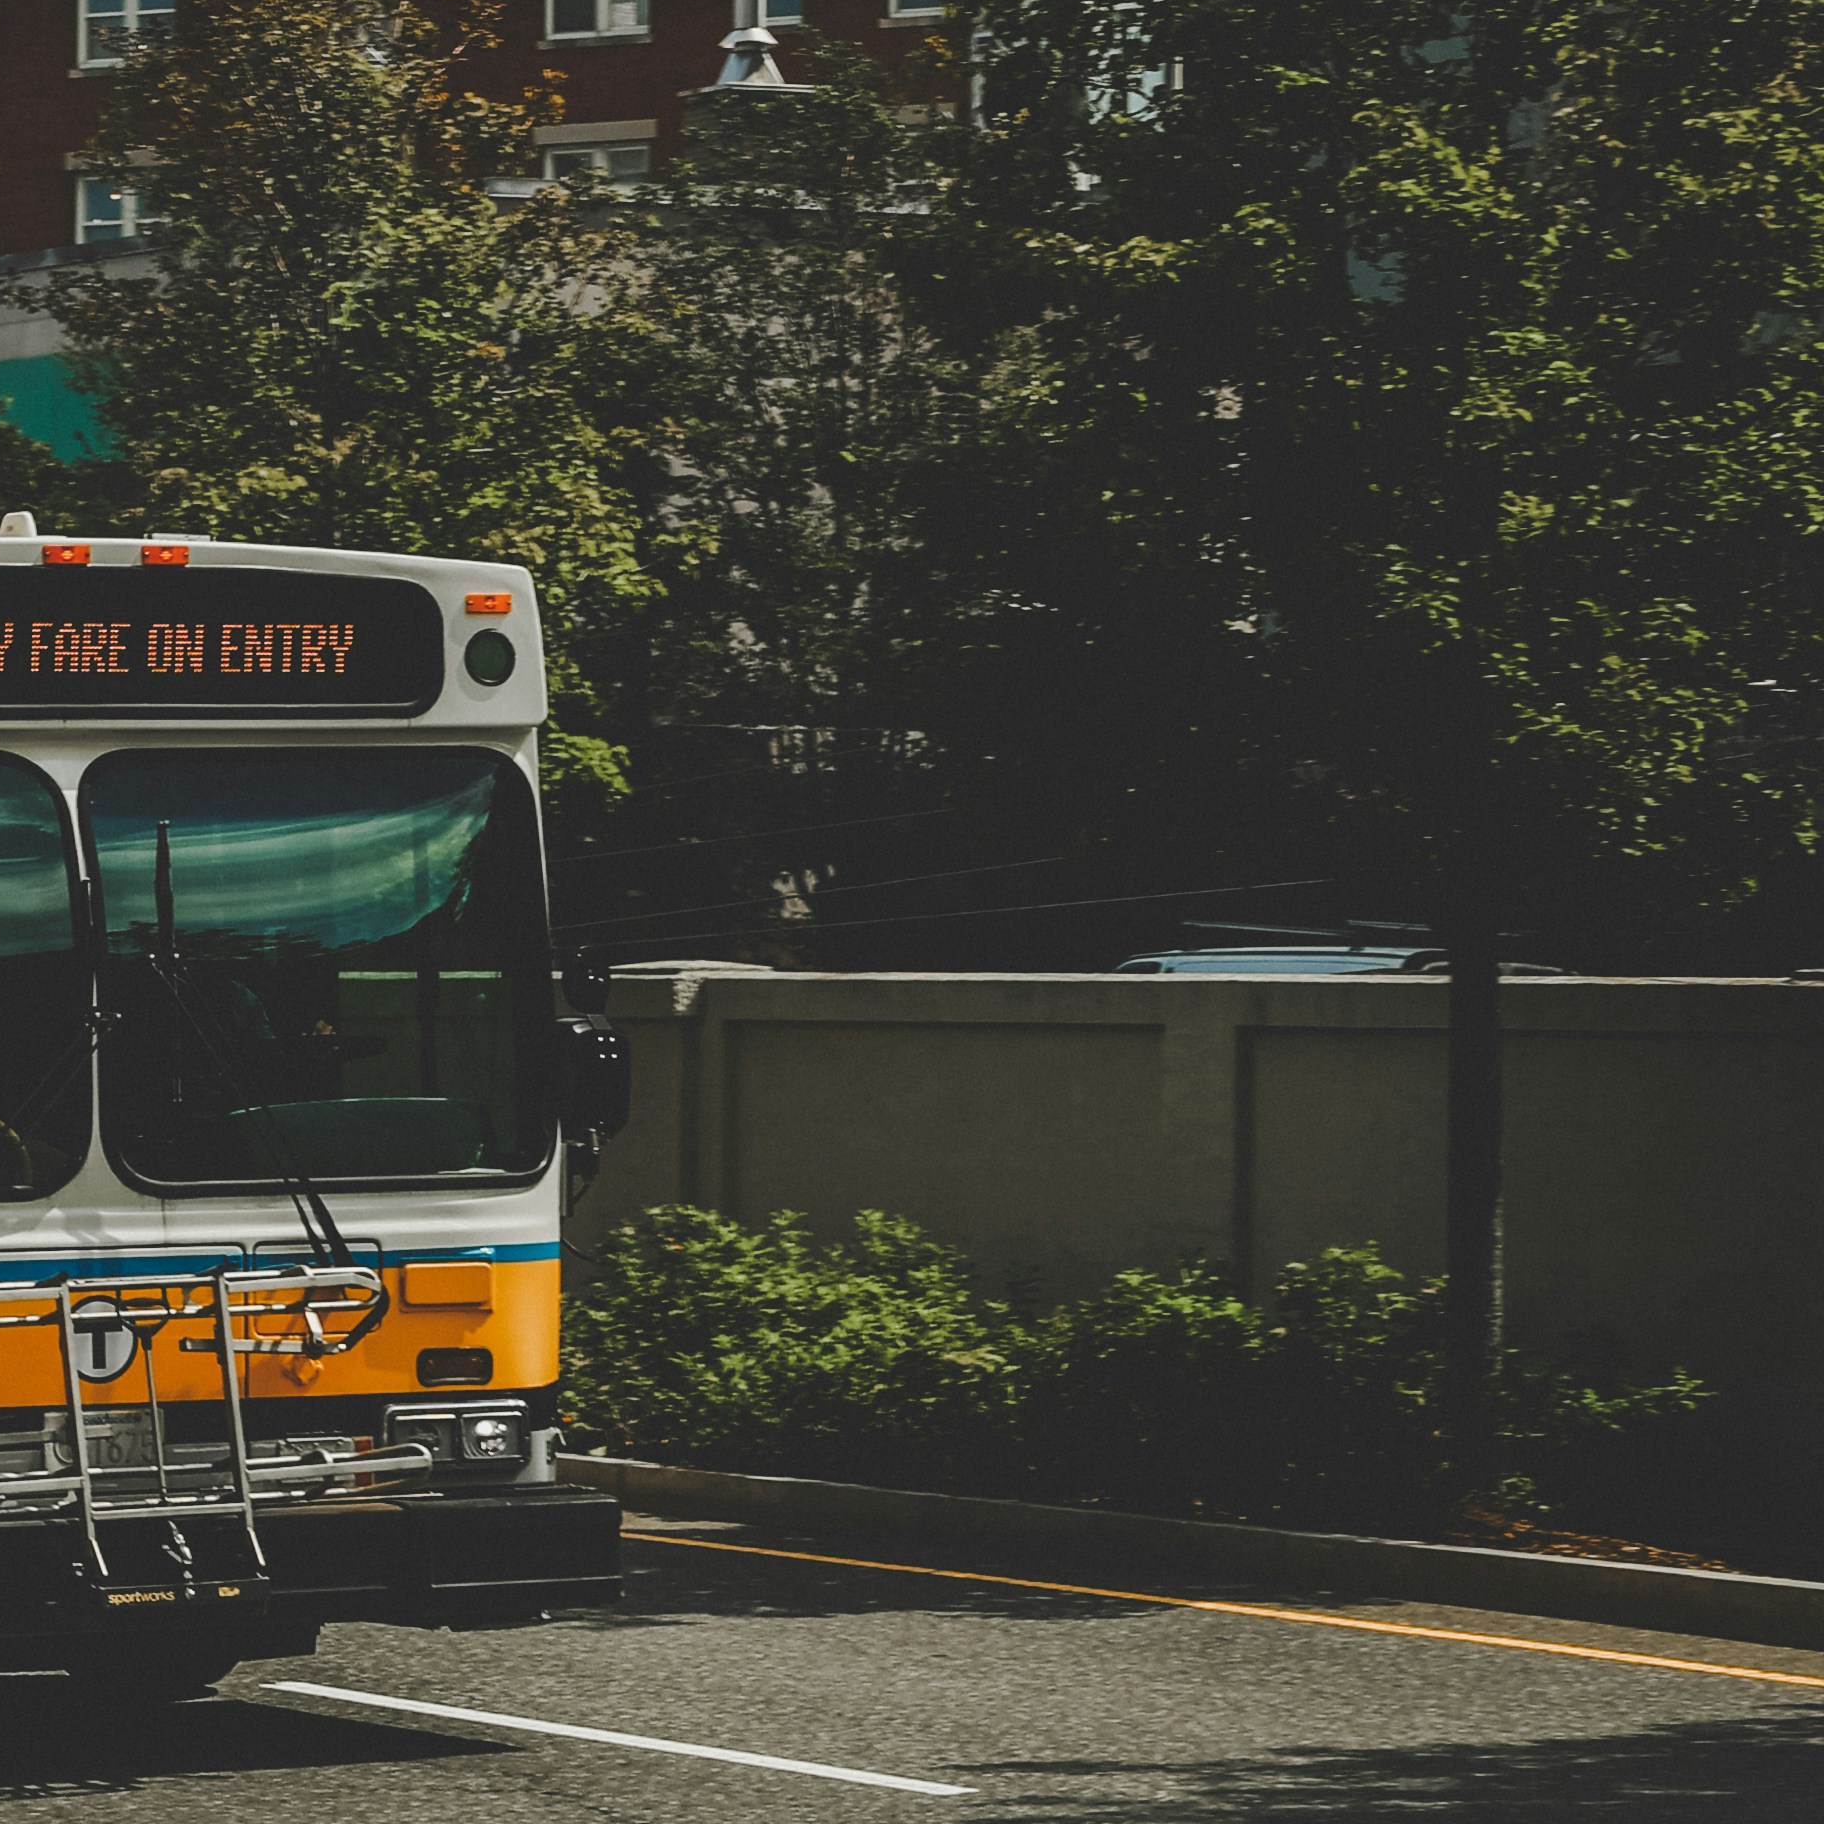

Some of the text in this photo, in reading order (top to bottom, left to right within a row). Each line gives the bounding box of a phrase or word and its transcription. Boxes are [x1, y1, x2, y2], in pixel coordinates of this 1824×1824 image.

[30, 622, 132, 673] FARE
[147, 623, 205, 673] ON
[220, 623, 355, 673] ENTRY
[107, 1590, 176, 1606] sportworks
